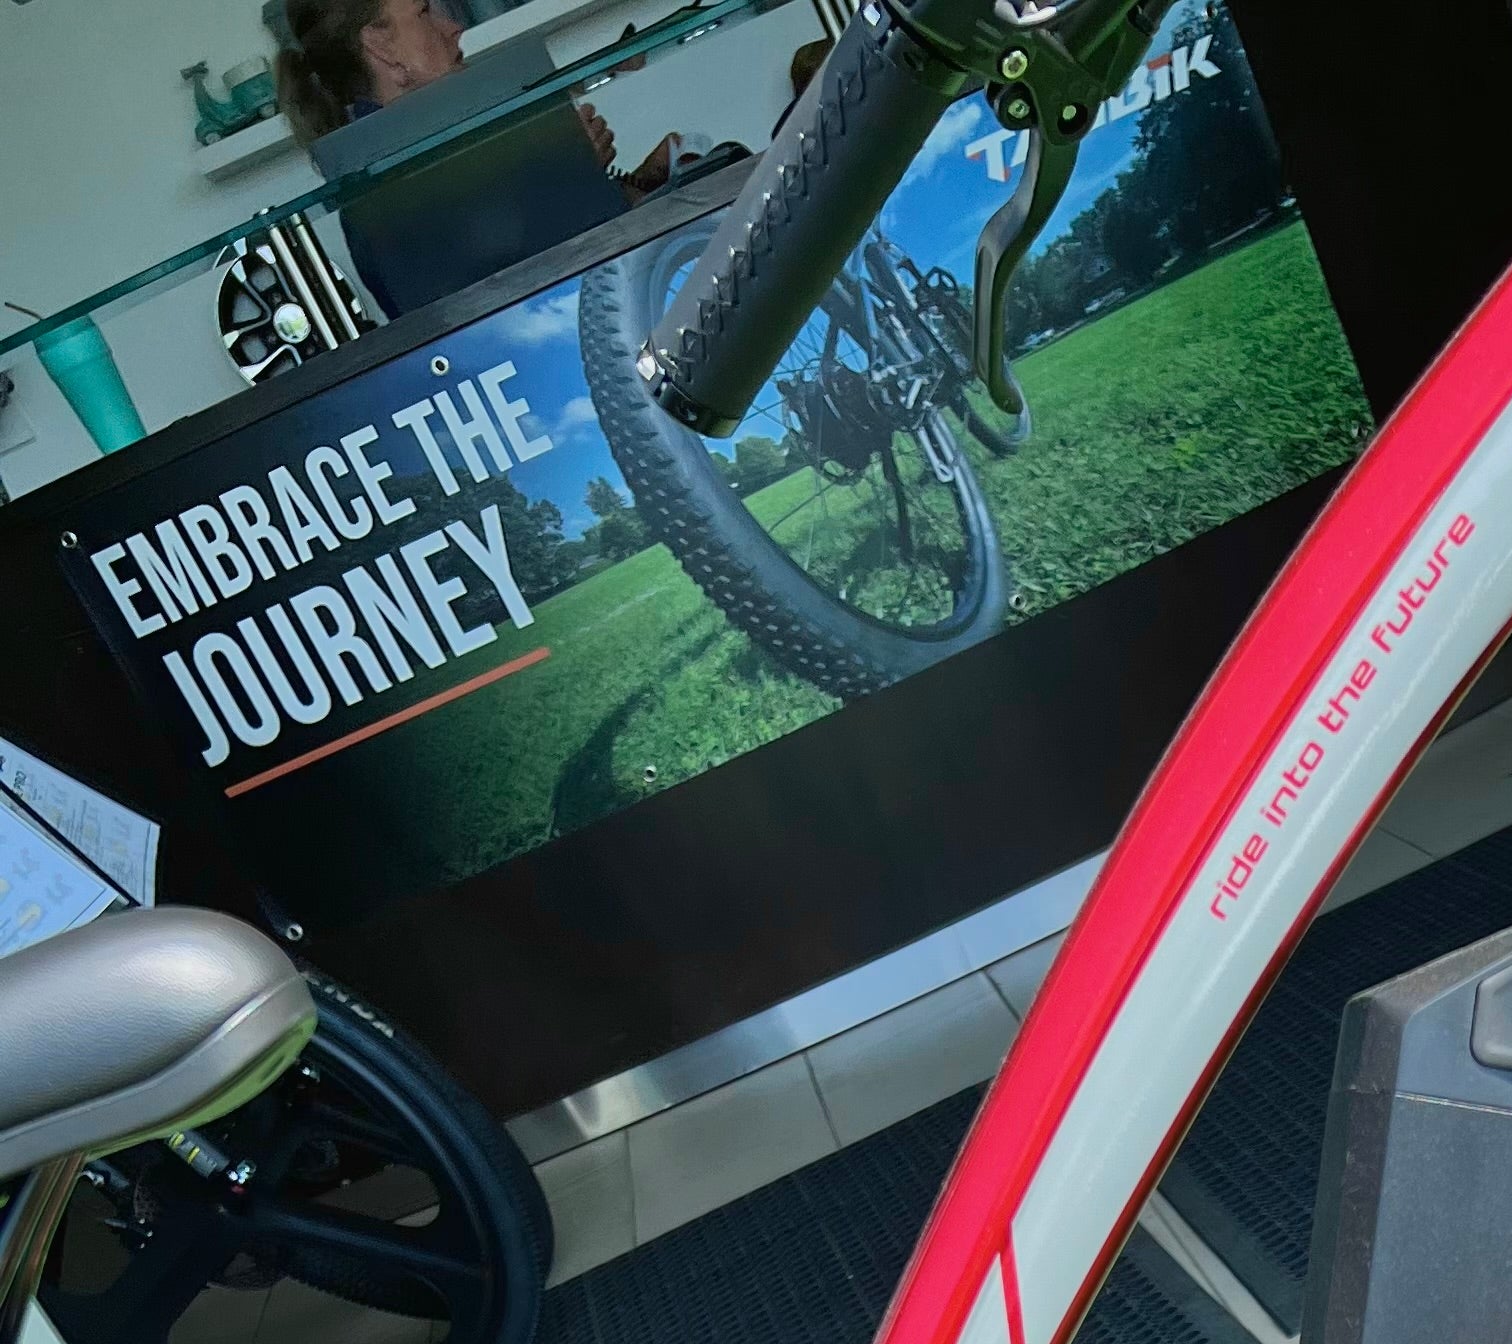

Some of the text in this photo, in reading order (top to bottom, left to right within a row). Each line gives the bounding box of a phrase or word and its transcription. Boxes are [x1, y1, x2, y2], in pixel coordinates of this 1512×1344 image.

[91, 360, 553, 639] EMBRACE THE
[162, 504, 535, 768] JOURNEY
[1210, 512, 1476, 921] ride into the future
